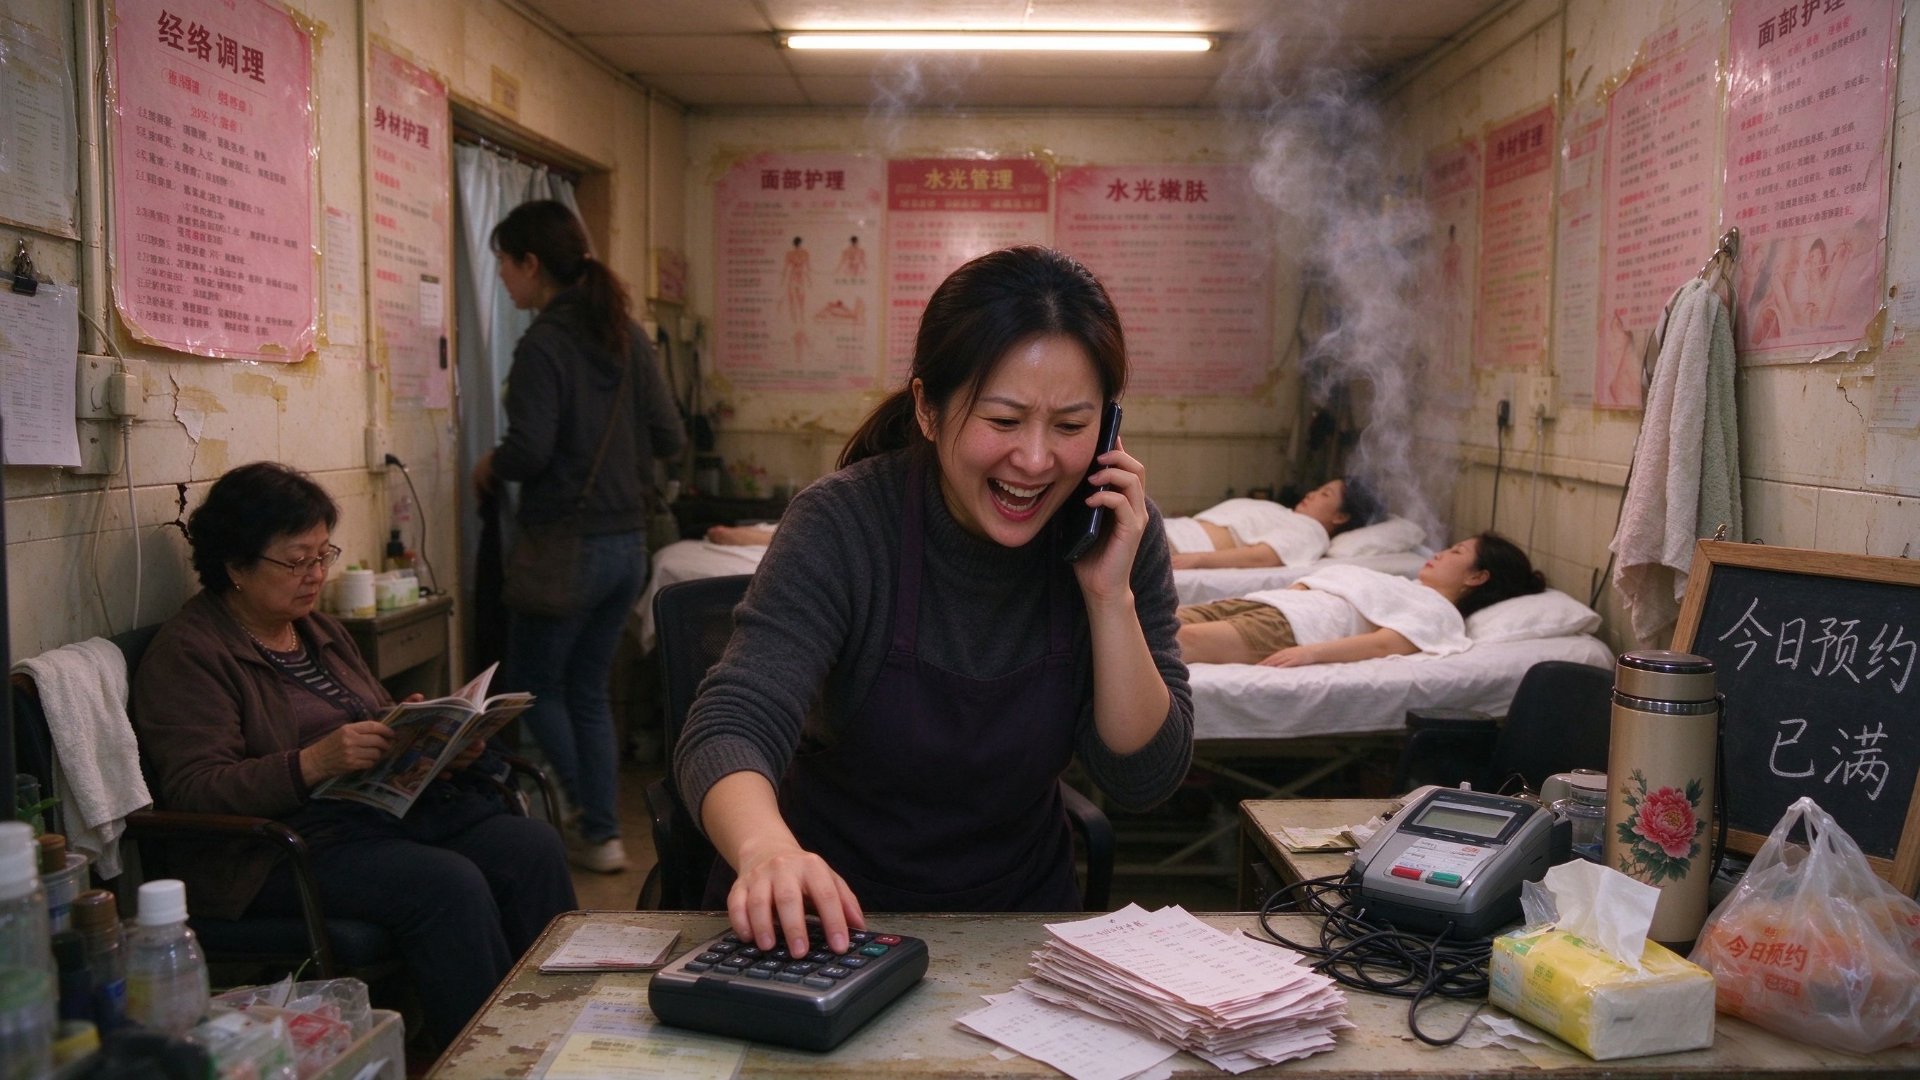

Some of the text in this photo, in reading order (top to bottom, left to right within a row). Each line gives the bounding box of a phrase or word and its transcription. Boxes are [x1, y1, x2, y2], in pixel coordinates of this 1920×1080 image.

[157, 9, 266, 84] 经络调理
[373, 104, 430, 149] 身材护理
[760, 168, 846, 191] 面部护理
[923, 167, 1014, 190] 水光管理
[1104, 177, 1209, 203] 水光嫩肤
[1718, 597, 1917, 693] 今日预约
[1768, 718, 1890, 801] 已满
[1725, 934, 1809, 972] 今日预约
